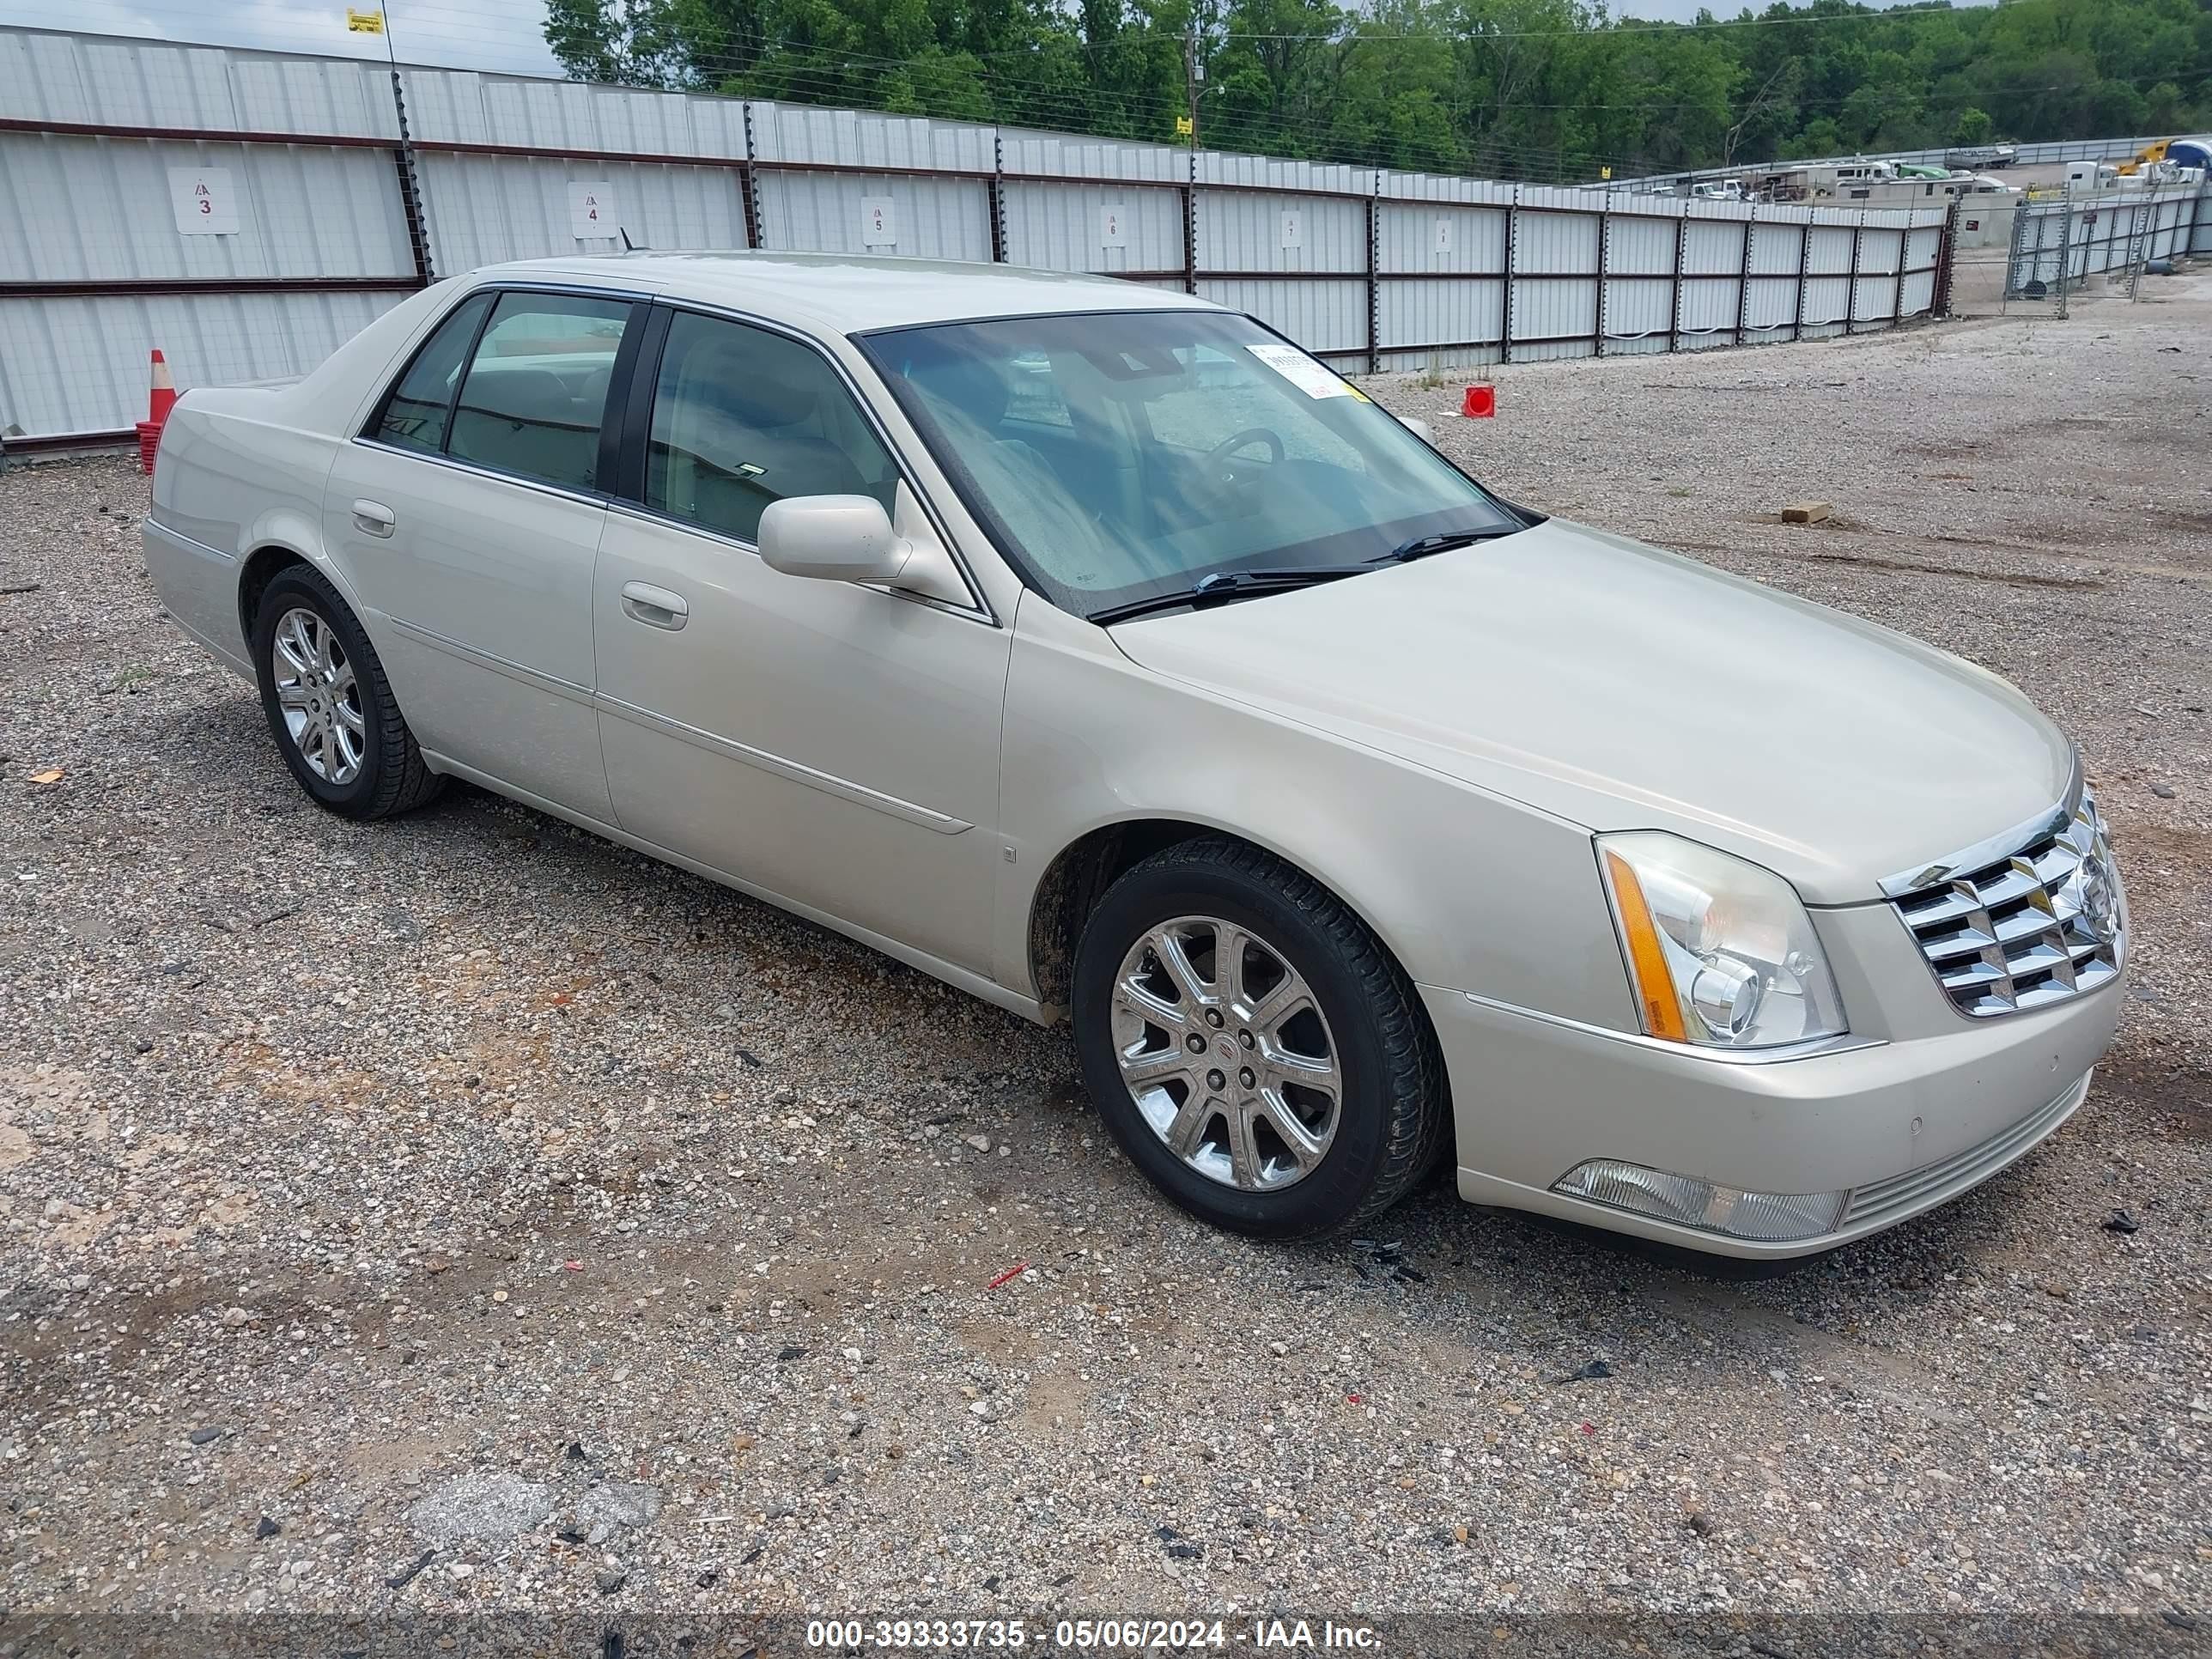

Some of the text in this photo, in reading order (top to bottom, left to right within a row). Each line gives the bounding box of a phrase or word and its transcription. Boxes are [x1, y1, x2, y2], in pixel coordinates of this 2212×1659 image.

[199, 199, 211, 214] 3
[589, 209, 598, 221] 4
[876, 220, 882, 231] 5
[1110, 225, 1116, 234] 6
